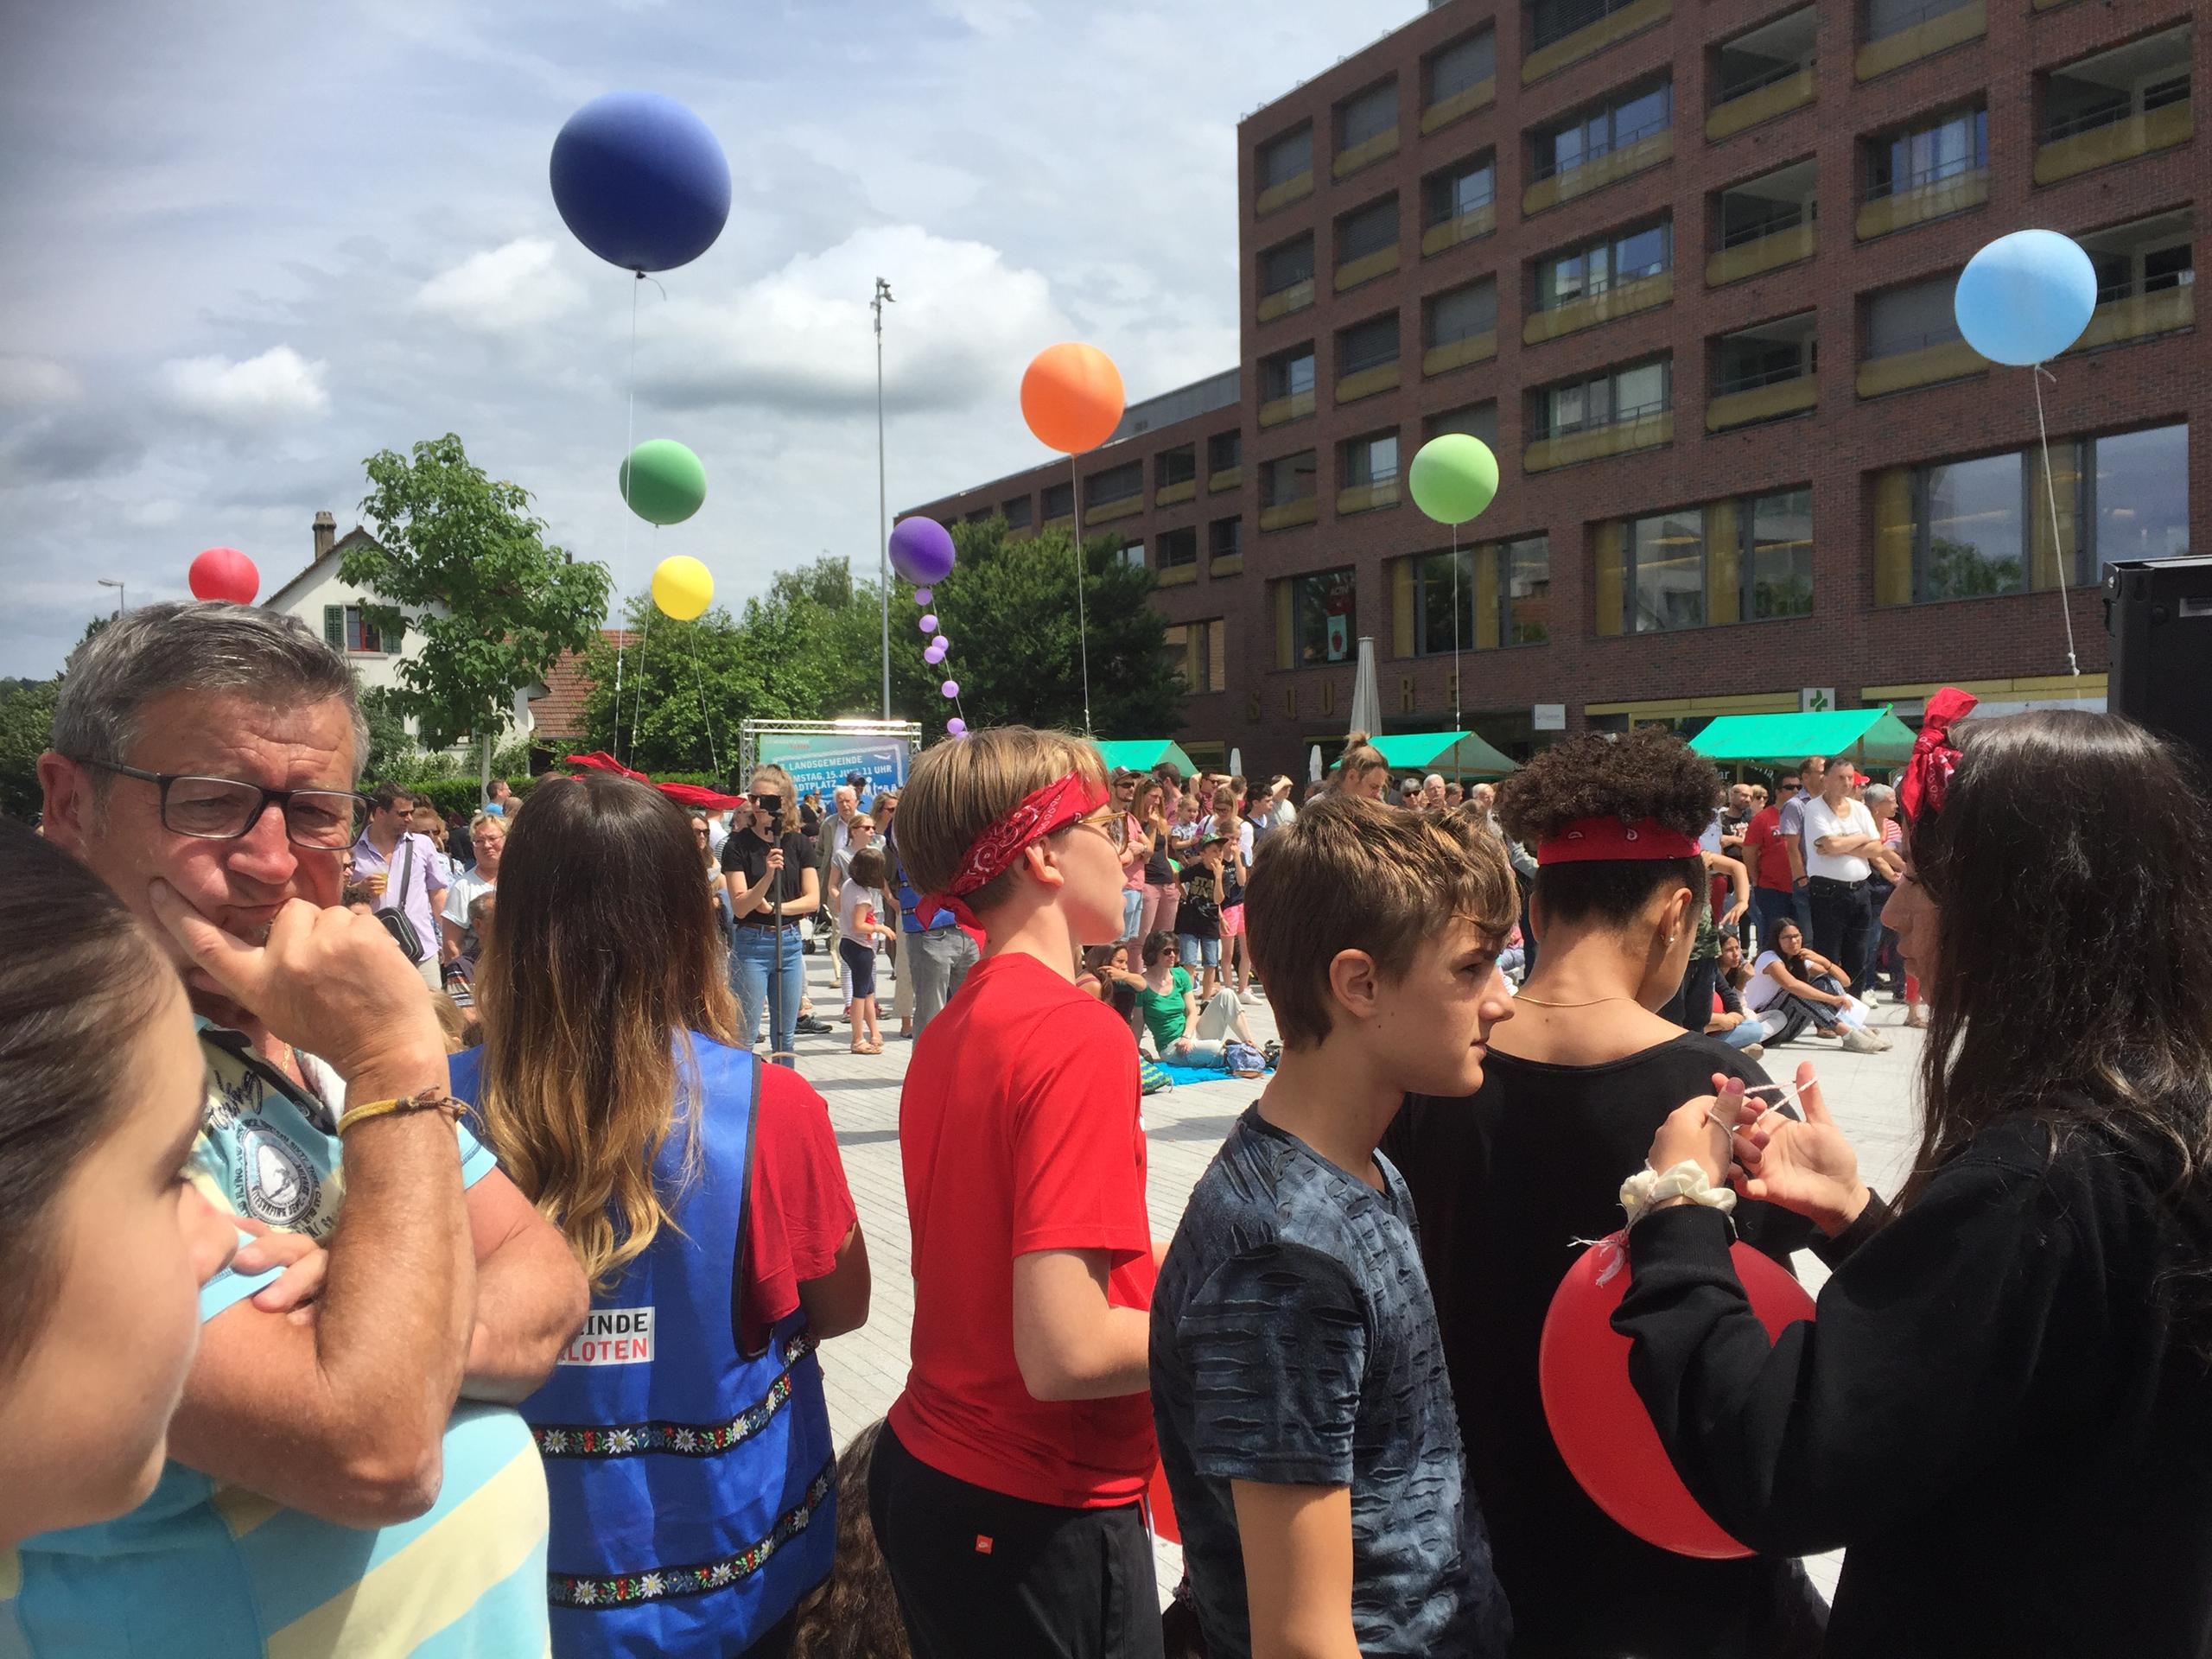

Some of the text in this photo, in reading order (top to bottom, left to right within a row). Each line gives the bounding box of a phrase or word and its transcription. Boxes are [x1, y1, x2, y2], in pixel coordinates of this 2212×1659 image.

[1248, 671, 1459, 720] SQURE
[789, 755, 863, 771] LANDSGEMEINDE
[793, 772, 825, 783] MSTAG,
[862, 766, 872, 775] 11
[874, 765, 892, 774] UHR
[794, 779, 836, 791] ADTPLATZ
[1192, 875, 1214, 887] STA
[581, 1313, 648, 1336] INDE
[561, 1337, 647, 1363] LOTEN
